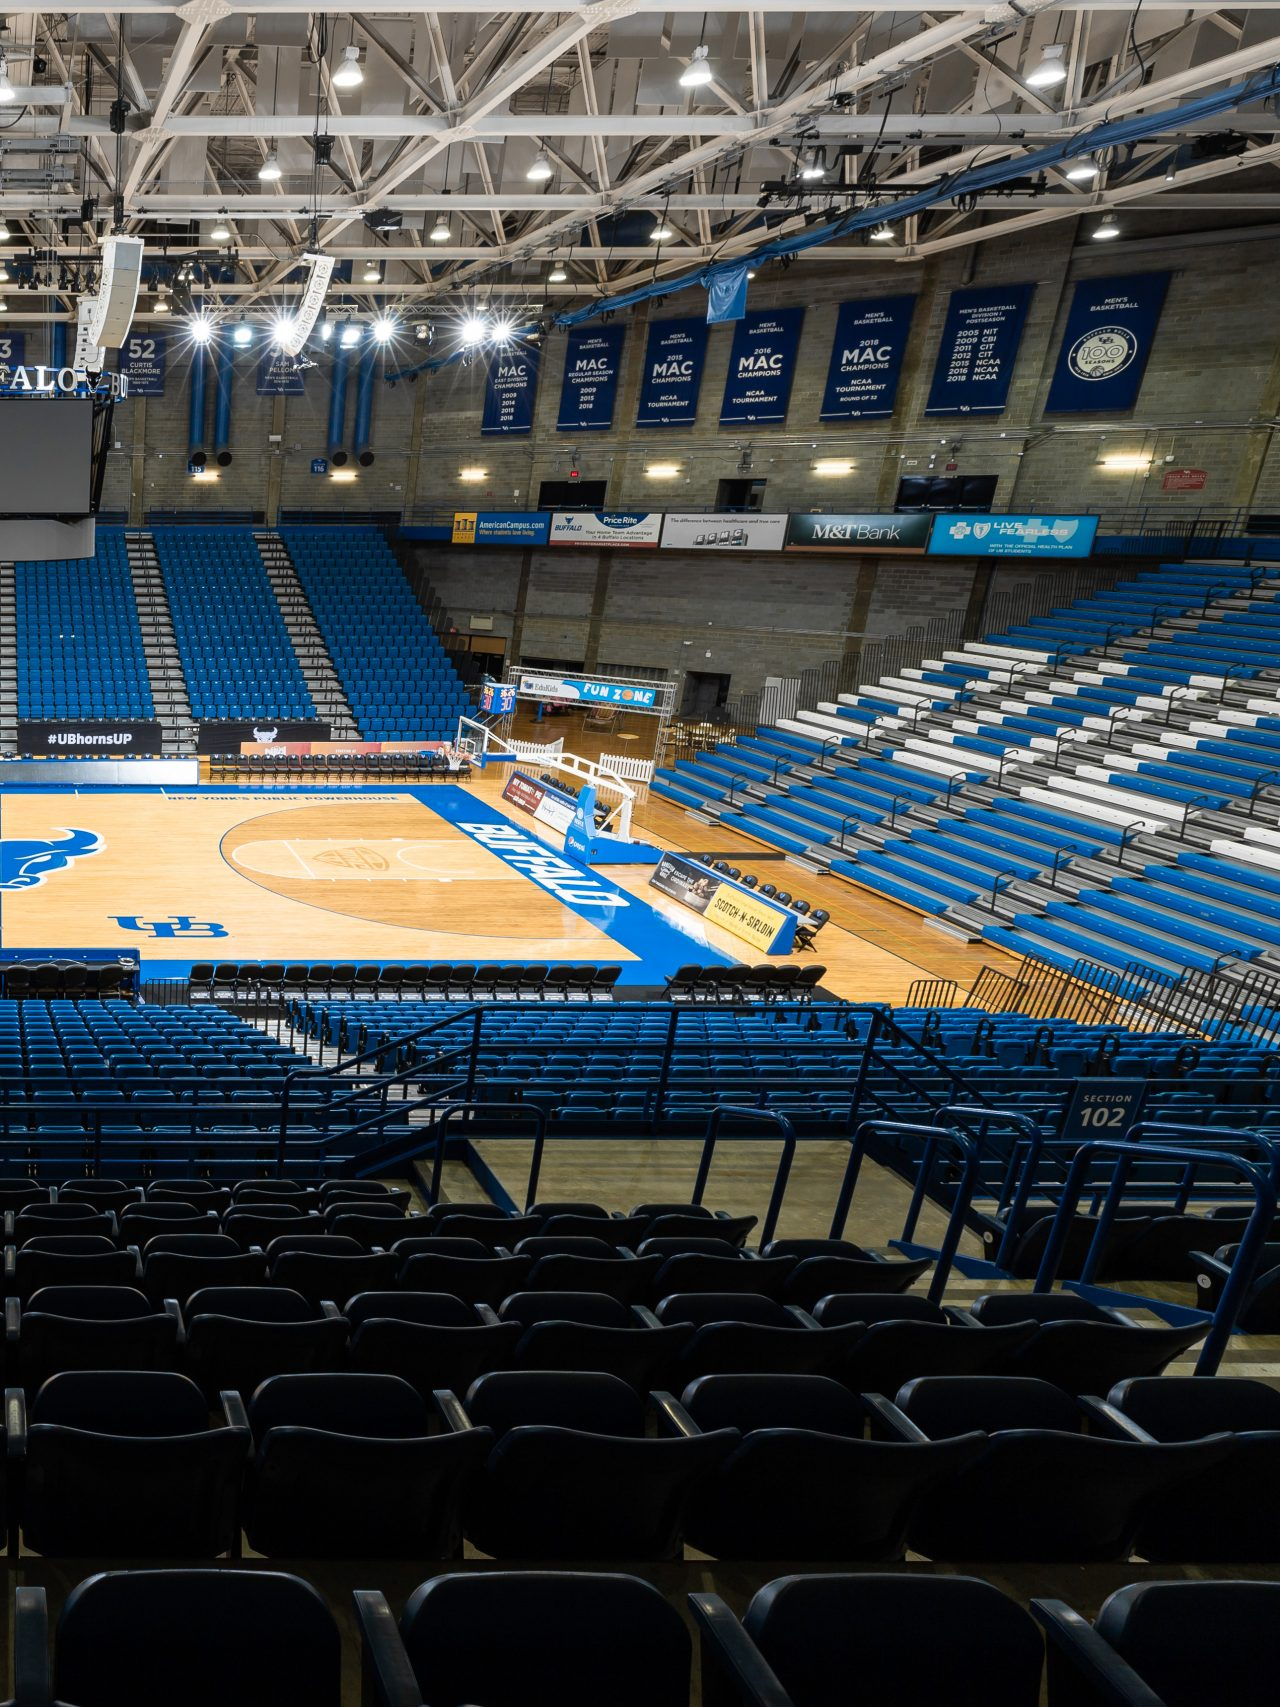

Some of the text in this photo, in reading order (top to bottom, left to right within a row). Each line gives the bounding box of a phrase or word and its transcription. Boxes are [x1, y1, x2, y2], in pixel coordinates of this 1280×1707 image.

[1090, 303, 1139, 311] BASKETBALL
[854, 317, 893, 325] BASKETBALL
[860, 339, 879, 347] 2018
[129, 339, 156, 359] 52
[754, 347, 771, 355] 2016
[1082, 345, 1124, 360] 100
[842, 346, 892, 364] MAC
[575, 358, 608, 371] MAC
[738, 354, 784, 371] MAC
[840, 363, 889, 372] CHAMPIONS
[498, 365, 526, 377] MAC
[652, 361, 693, 377] MAC
[737, 369, 781, 378] CHAMPIONS
[651, 376, 691, 384] CHAMPIONS
[835, 384, 886, 393] TOURNAMENT
[732, 396, 778, 404] TOURNAMENT
[479, 521, 544, 530] AmericanCampus.com
[603, 516, 637, 524] Price Rite
[812, 524, 900, 540] M&T Bank
[999, 528, 1069, 536] FEARLESS
[534, 683, 558, 693] EduKids
[583, 683, 653, 703] FUN ZONE
[48, 734, 132, 745] #UBhornsUP
[457, 822, 630, 907] BUFFALO
[714, 898, 775, 937] SCOTCH-N-SIRLOIN
[107, 916, 230, 938] UB
[1081, 1107, 1125, 1127] 102
